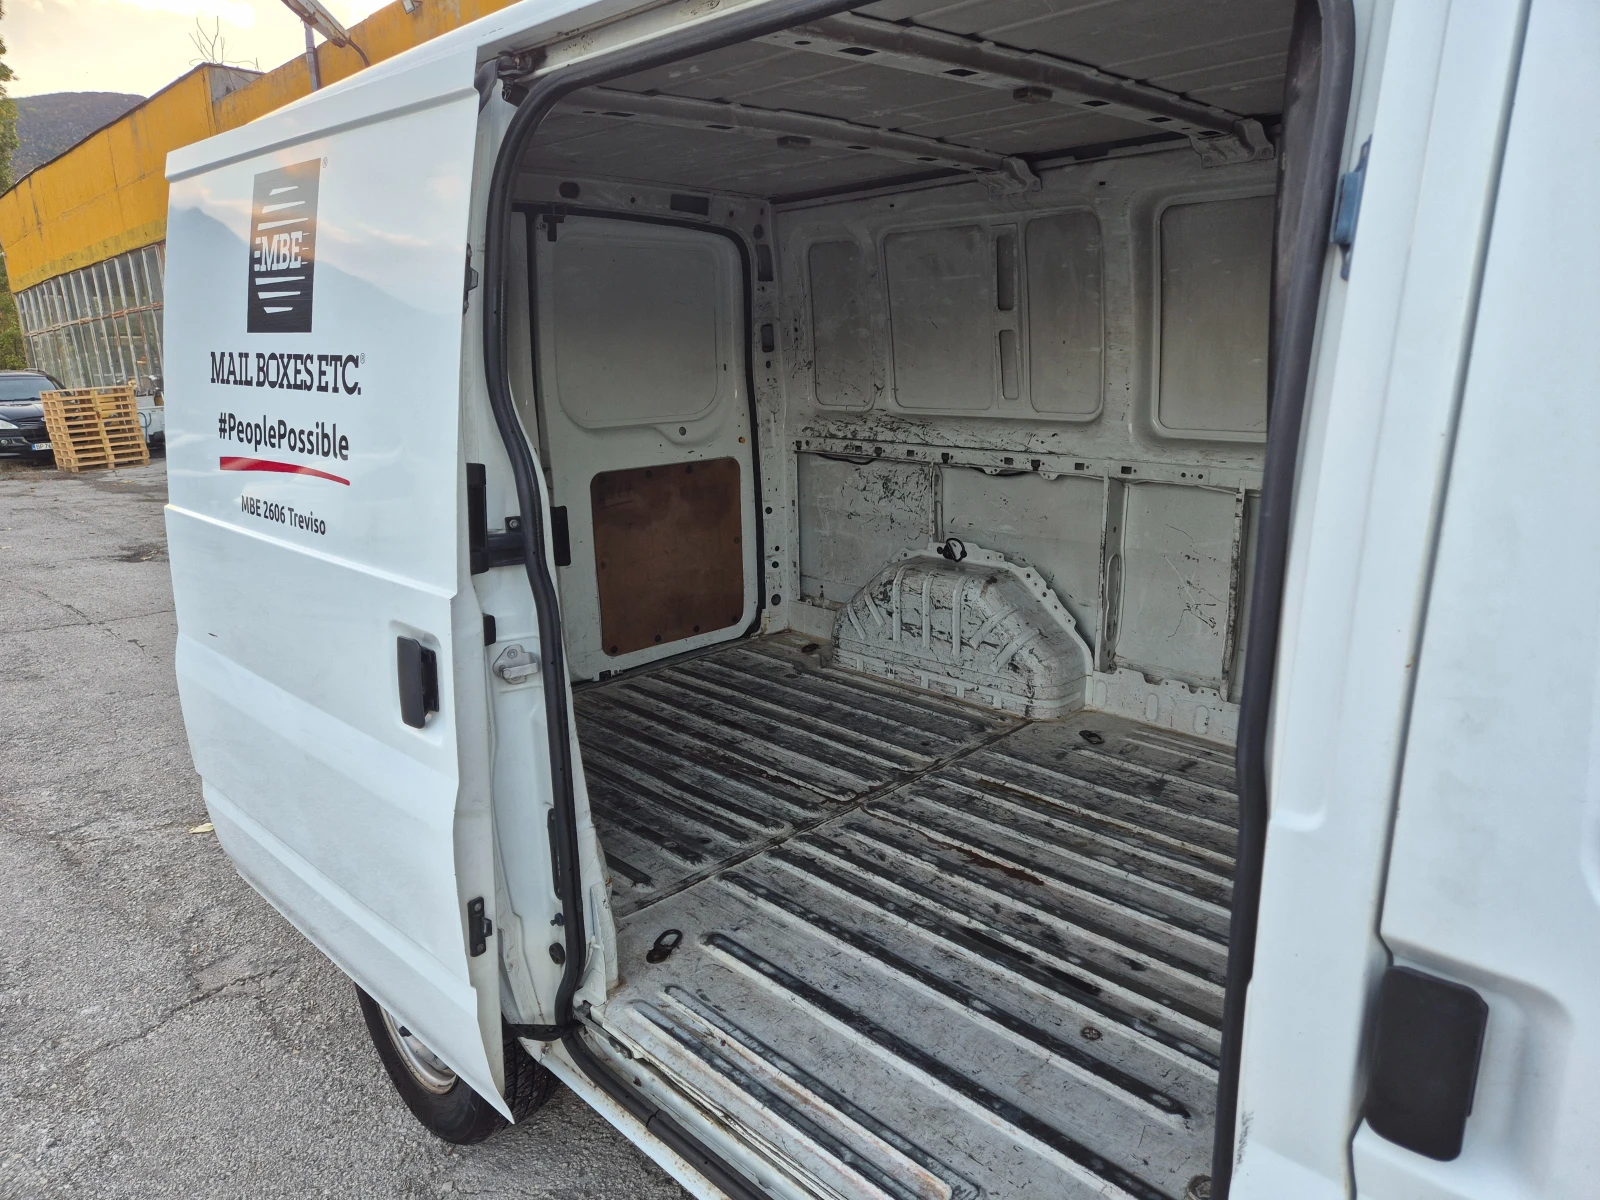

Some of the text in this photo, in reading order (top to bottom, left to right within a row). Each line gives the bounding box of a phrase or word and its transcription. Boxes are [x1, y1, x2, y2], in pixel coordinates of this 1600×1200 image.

[260, 231, 302, 271] MBE
[210, 351, 253, 387] MAIL
[255, 352, 314, 392] BOXES
[218, 412, 349, 461] #PeoplePossible
[241, 495, 326, 536] MBE 2606 Treviso
